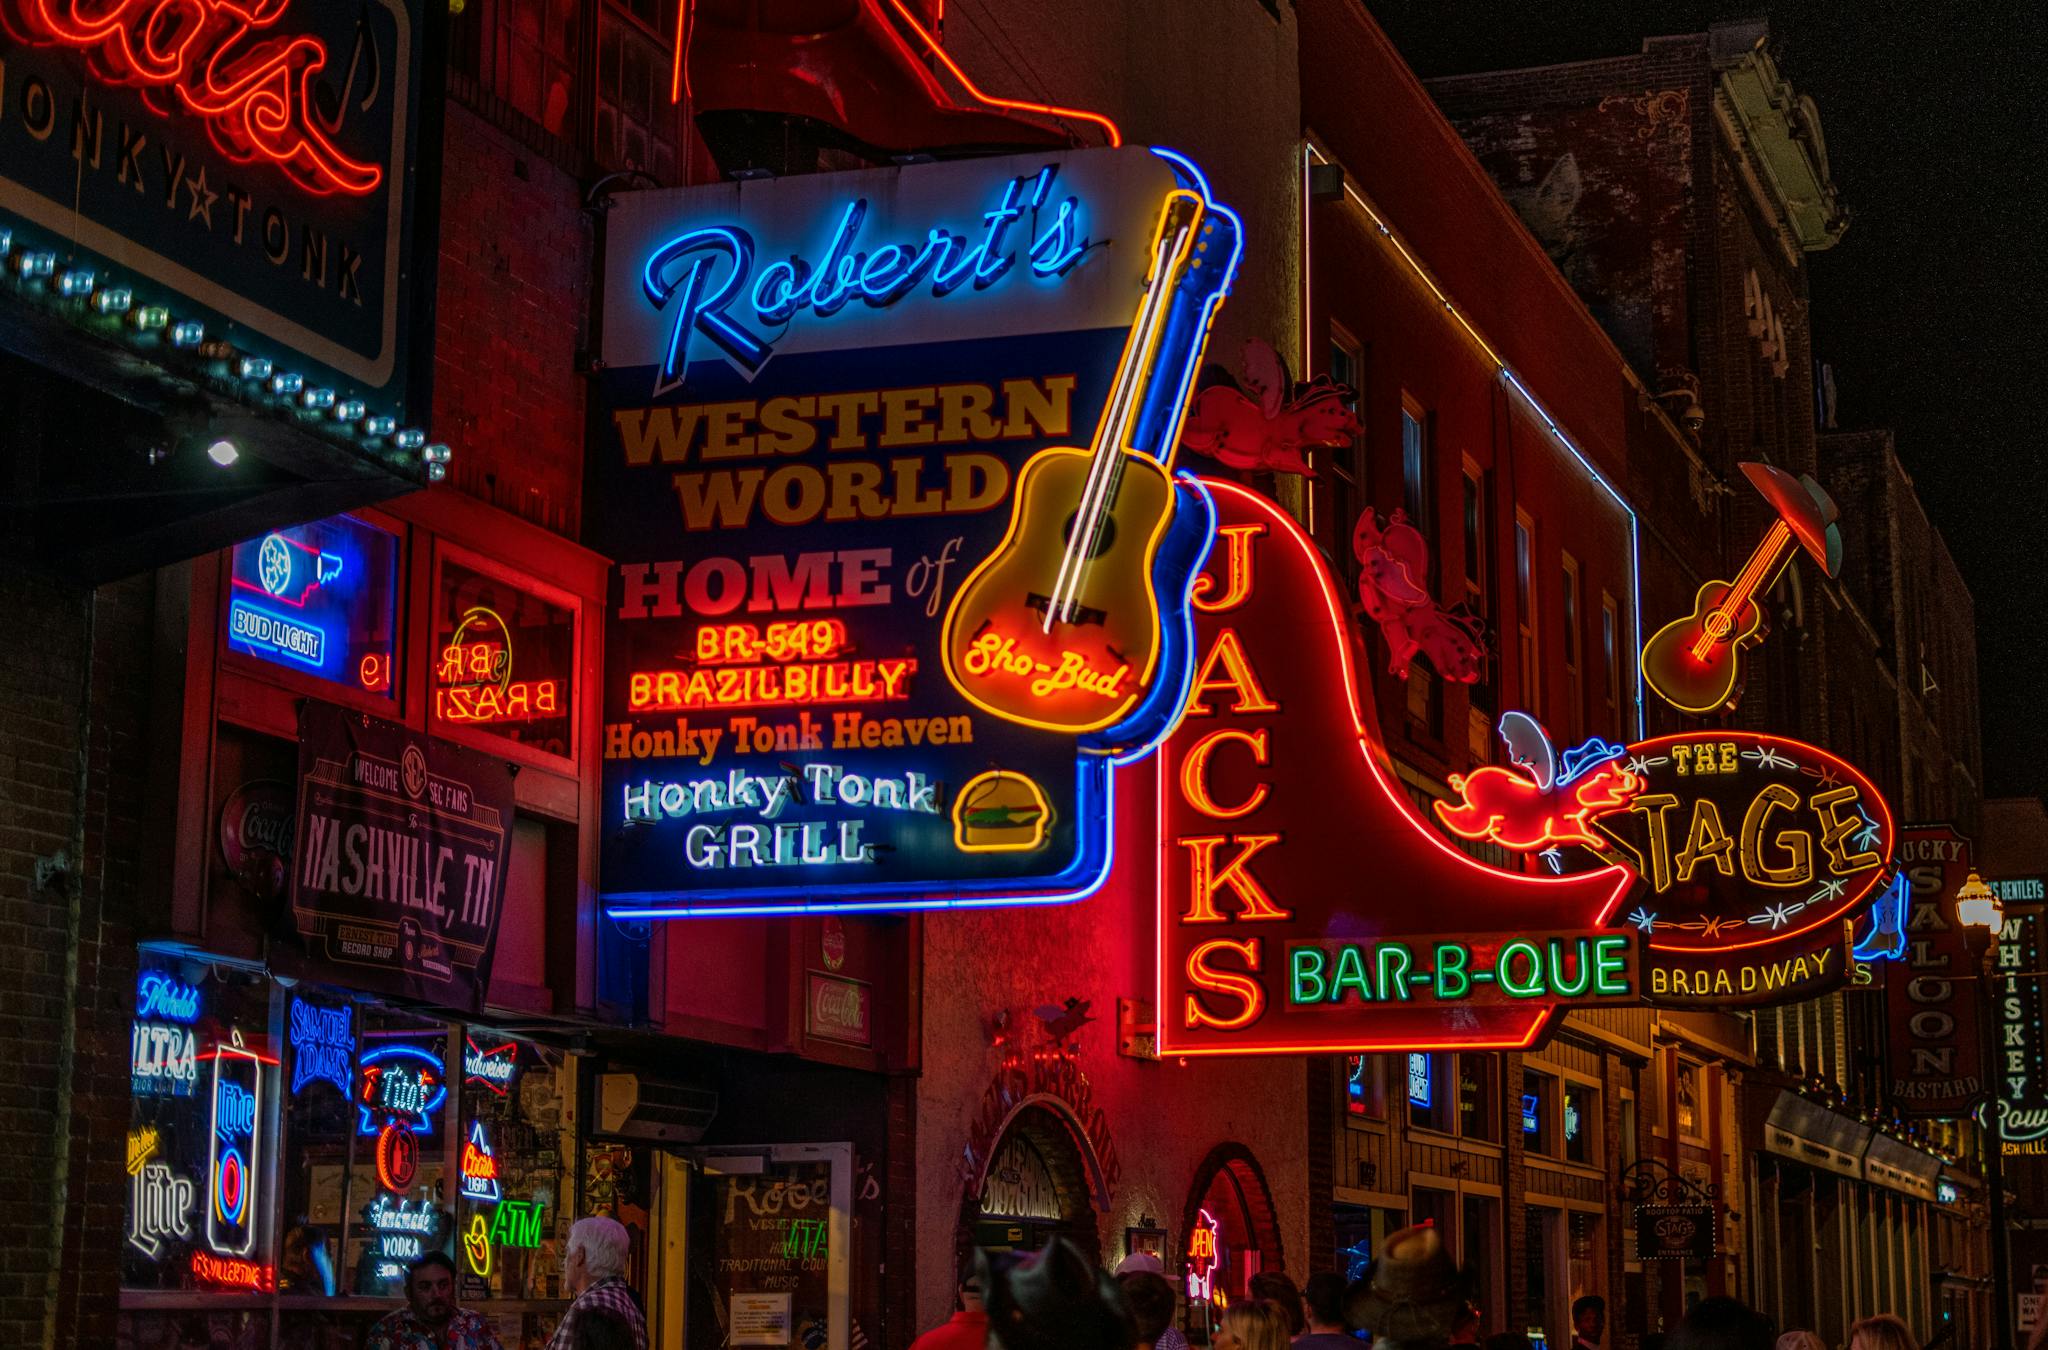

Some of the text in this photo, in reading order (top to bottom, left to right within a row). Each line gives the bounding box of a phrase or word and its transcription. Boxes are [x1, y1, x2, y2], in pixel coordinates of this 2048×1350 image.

[0, 57, 185, 209] ONKY
[227, 184, 364, 307] TONK
[643, 164, 1088, 394] Robert's
[614, 373, 1077, 466] WESTERN
[672, 452, 1011, 532] WORLD
[617, 536, 963, 619] HOME of
[233, 608, 319, 658] BUD LIGHT
[696, 619, 844, 661] BR-549
[629, 659, 912, 710] BRAZILBILLY
[964, 631, 1131, 699] Sho-Bud
[604, 718, 724, 767] Honky
[730, 711, 823, 755] Tonk
[832, 712, 974, 751] Heaven
[1671, 743, 1738, 776] THE
[354, 758, 399, 793] WELCOME
[429, 781, 469, 813] SEC FANS
[624, 763, 942, 820] Honky Tonk
[685, 820, 872, 869] GRILL
[1902, 839, 1964, 863] UCKY
[303, 813, 494, 928] NASHVILLE, TN
[341, 940, 393, 960] RECORD SHOP
[1289, 933, 1632, 1005] BAR-B-QUE
[1652, 948, 1831, 995] BROADWAY
[1908, 866, 1955, 1075] SALOON
[291, 997, 355, 1052] SAMUEL
[292, 1042, 348, 1093] ADAMS
[466, 1050, 515, 1080] udweiser
[1893, 1075, 1980, 1099] BASTARD
[215, 1080, 255, 1140] Lite
[2001, 1137, 2047, 1156] ASHVILLE
[129, 1163, 193, 1256] Lite
[490, 1200, 545, 1249] ATM
[383, 1236, 420, 1257] VODKA
[720, 1258, 793, 1272] TRADITIONAL
[763, 1275, 800, 1289] MUSIC
